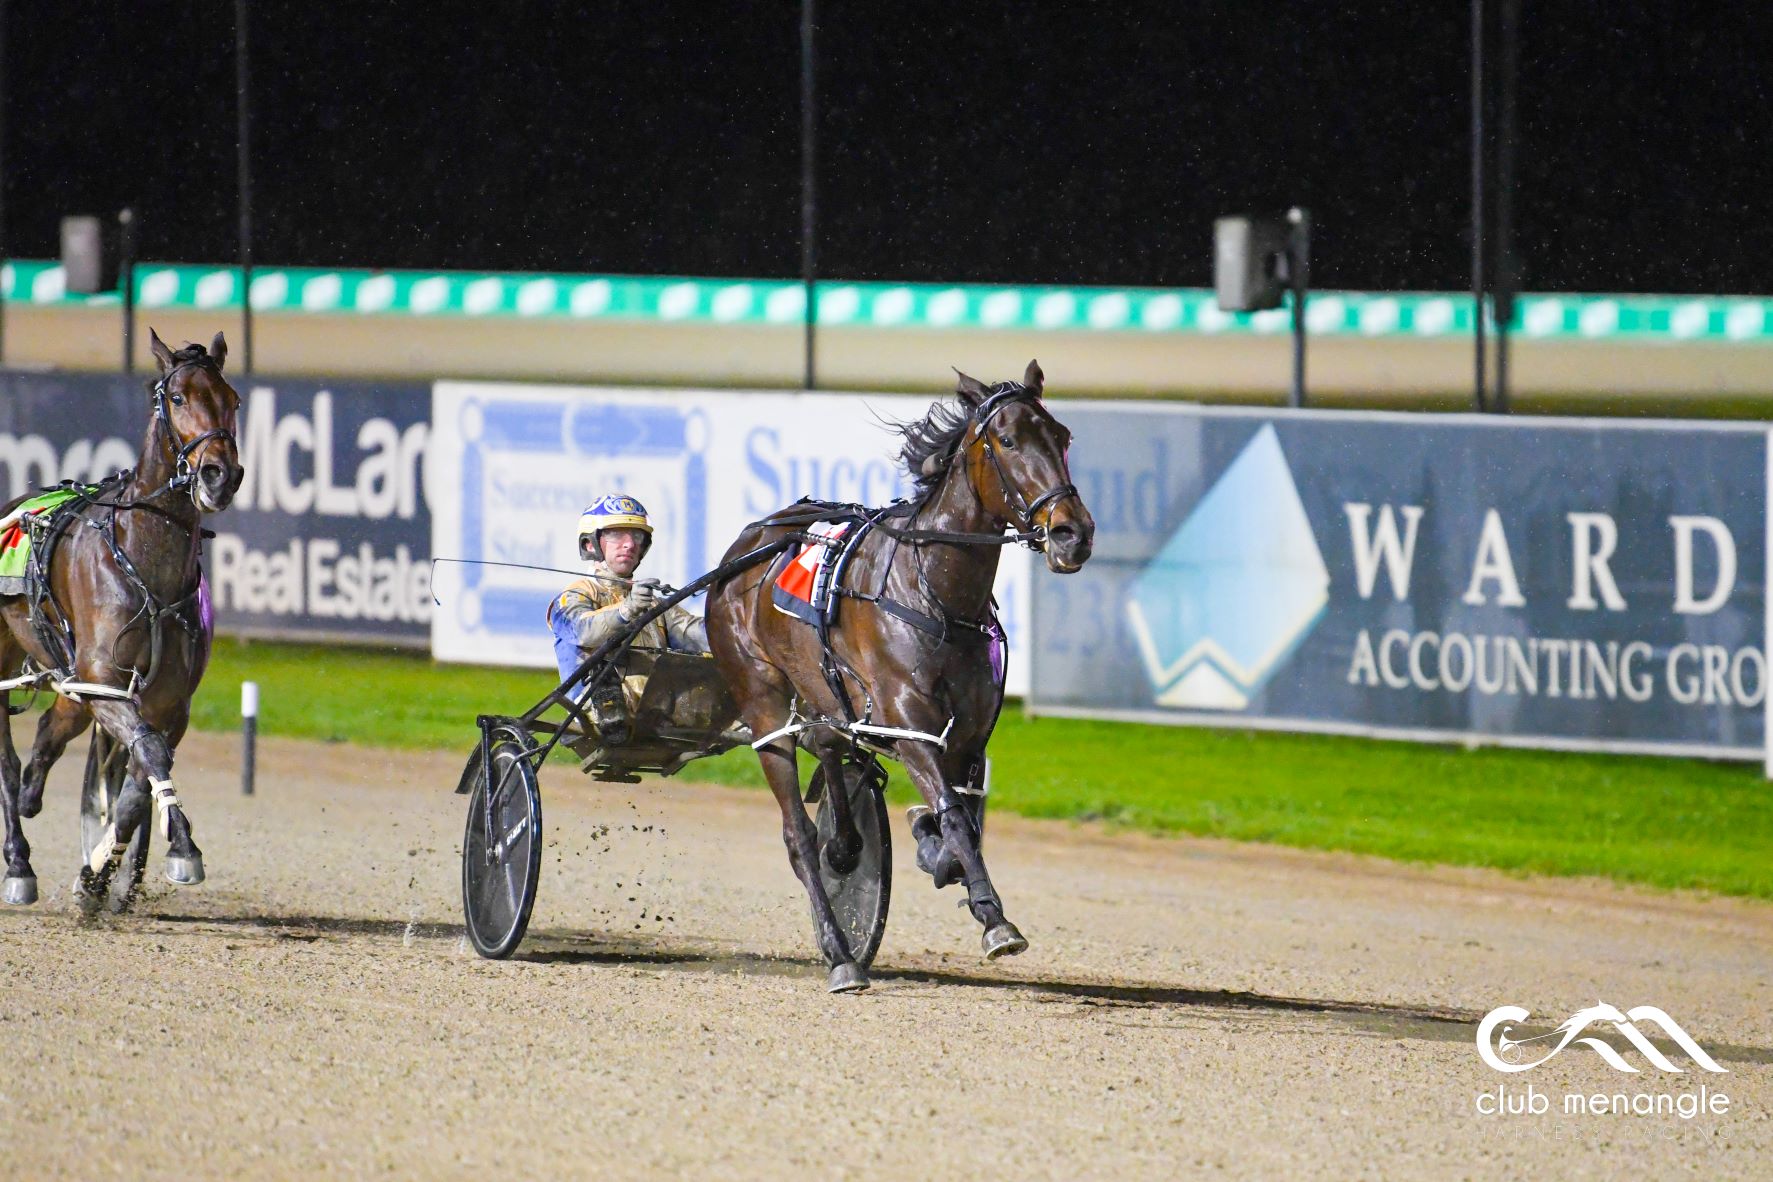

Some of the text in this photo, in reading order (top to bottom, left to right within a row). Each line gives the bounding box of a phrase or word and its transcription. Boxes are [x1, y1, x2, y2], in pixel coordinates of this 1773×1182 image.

[236, 386, 432, 520] McLar
[211, 532, 432, 624] Real Estate
[1343, 502, 1738, 615] WARD
[1348, 628, 1767, 708] ACCOUNTING GRO
